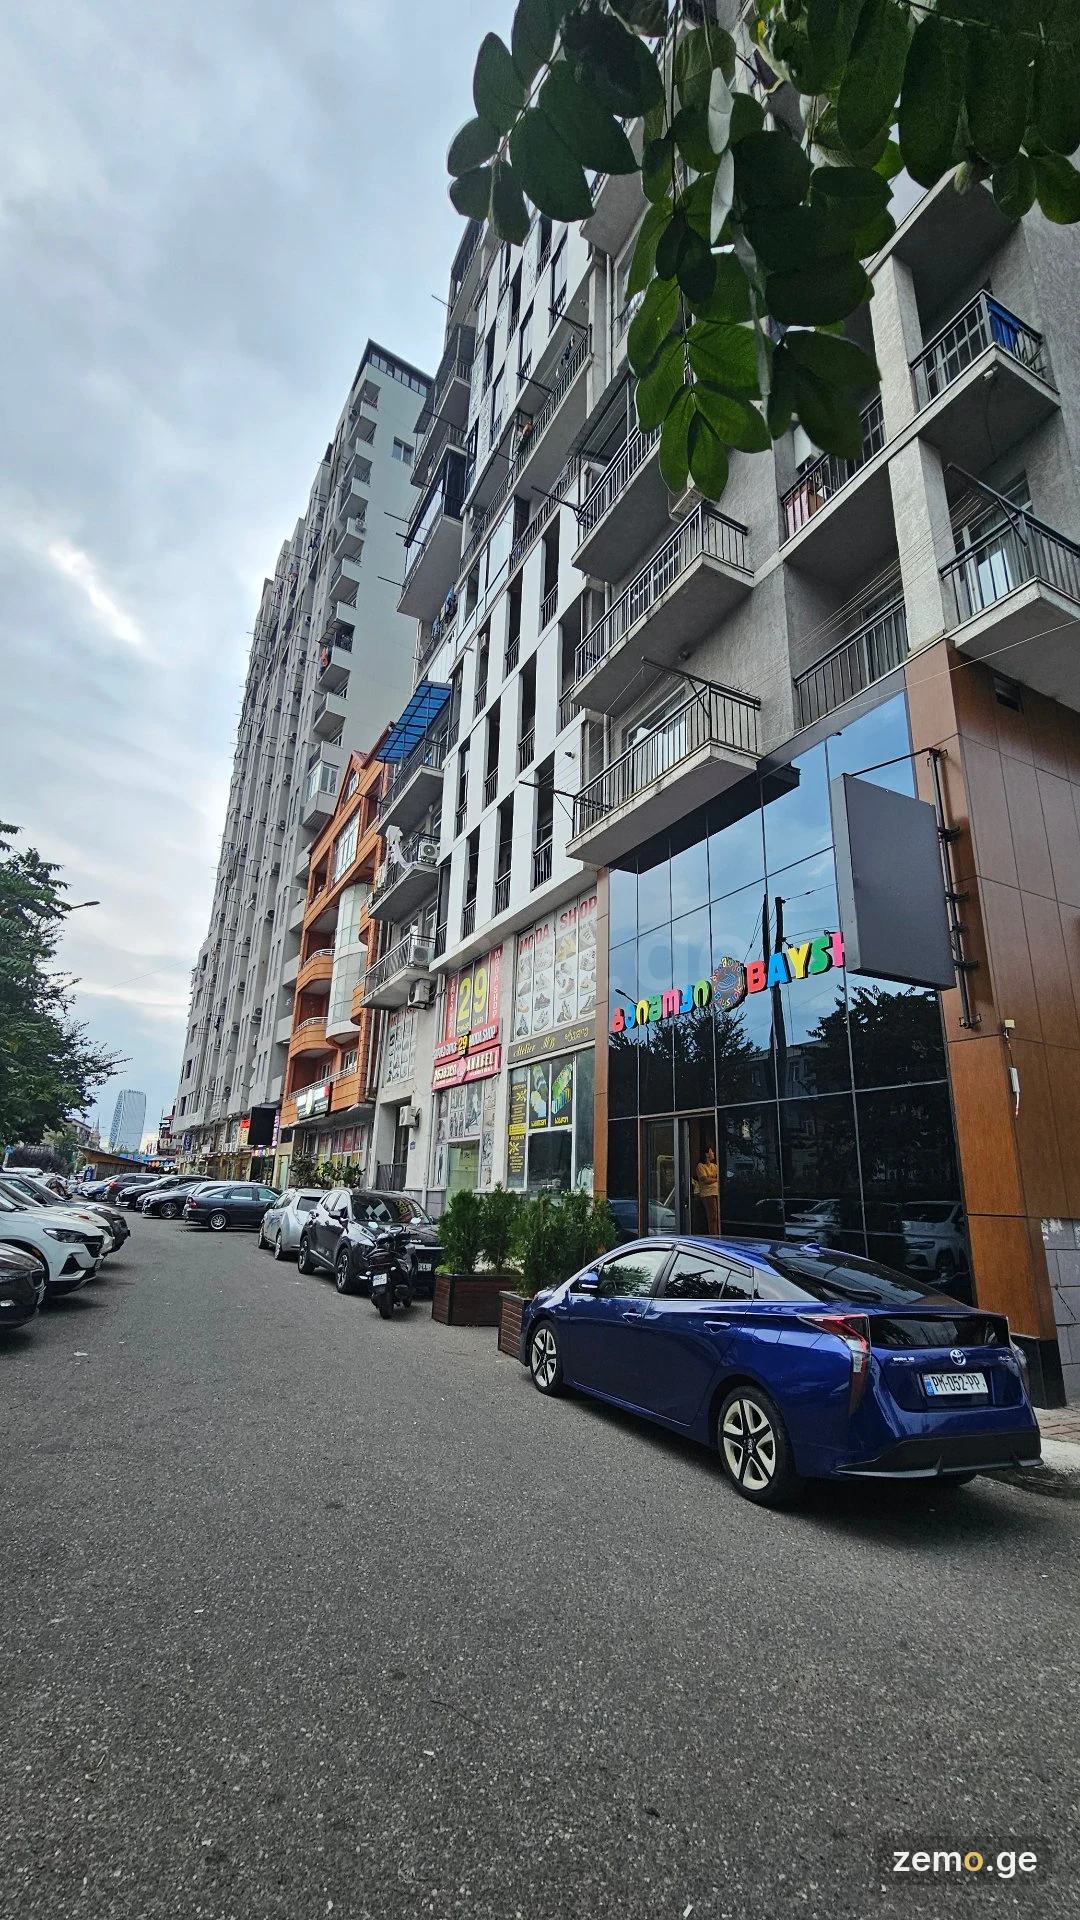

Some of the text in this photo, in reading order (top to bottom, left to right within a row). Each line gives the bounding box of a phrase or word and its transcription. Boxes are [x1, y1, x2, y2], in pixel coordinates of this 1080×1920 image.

[518, 896, 597, 955] MODA SHOP
[457, 967, 488, 1022] 29
[458, 1035, 468, 1050] 29
